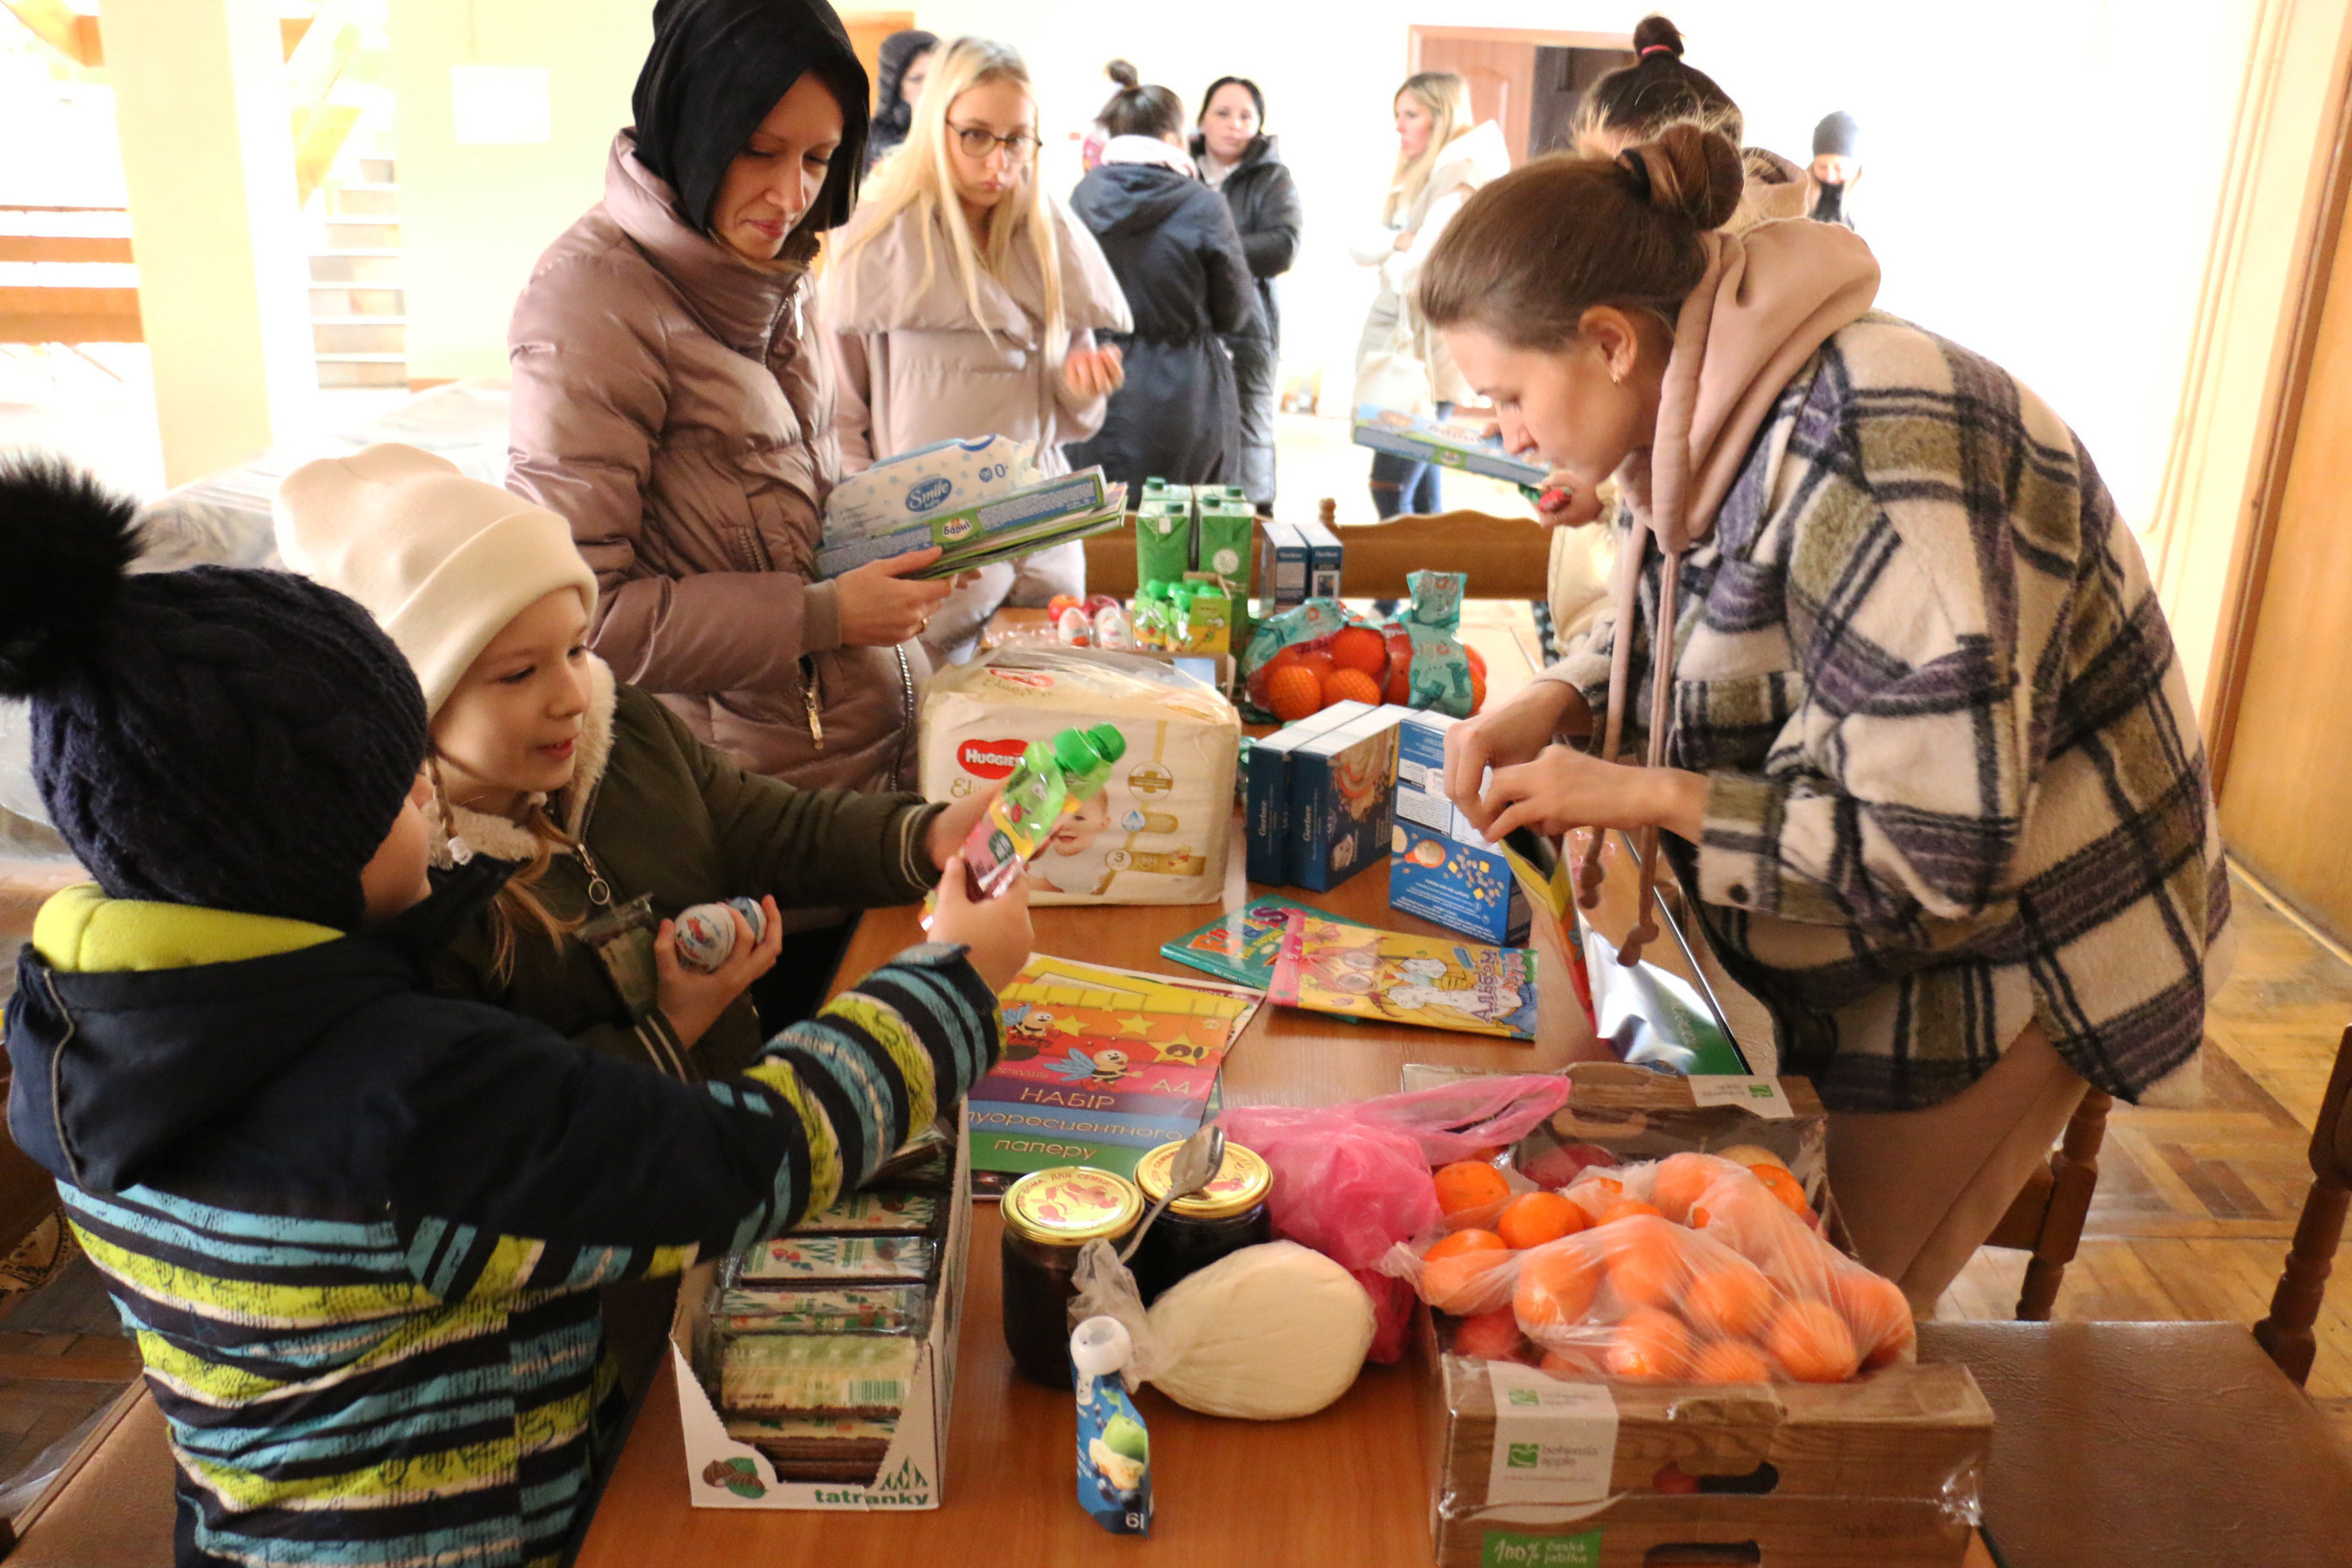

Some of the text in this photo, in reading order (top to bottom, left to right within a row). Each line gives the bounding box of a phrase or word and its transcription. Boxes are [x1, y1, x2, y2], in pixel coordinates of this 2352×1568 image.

[909, 482, 949, 510] Smile
[943, 521, 970, 536] Барні
[1302, 805, 1311, 841] Gerber
[1470, 950, 1497, 1024] Альбом
[1020, 1087, 1115, 1109] НАБІР
[968, 1112, 1183, 1141] луоресцентного
[994, 1139, 1098, 1160] паперу
[814, 1490, 929, 1505] tatranky
[1494, 1538, 1541, 1566] 100%
